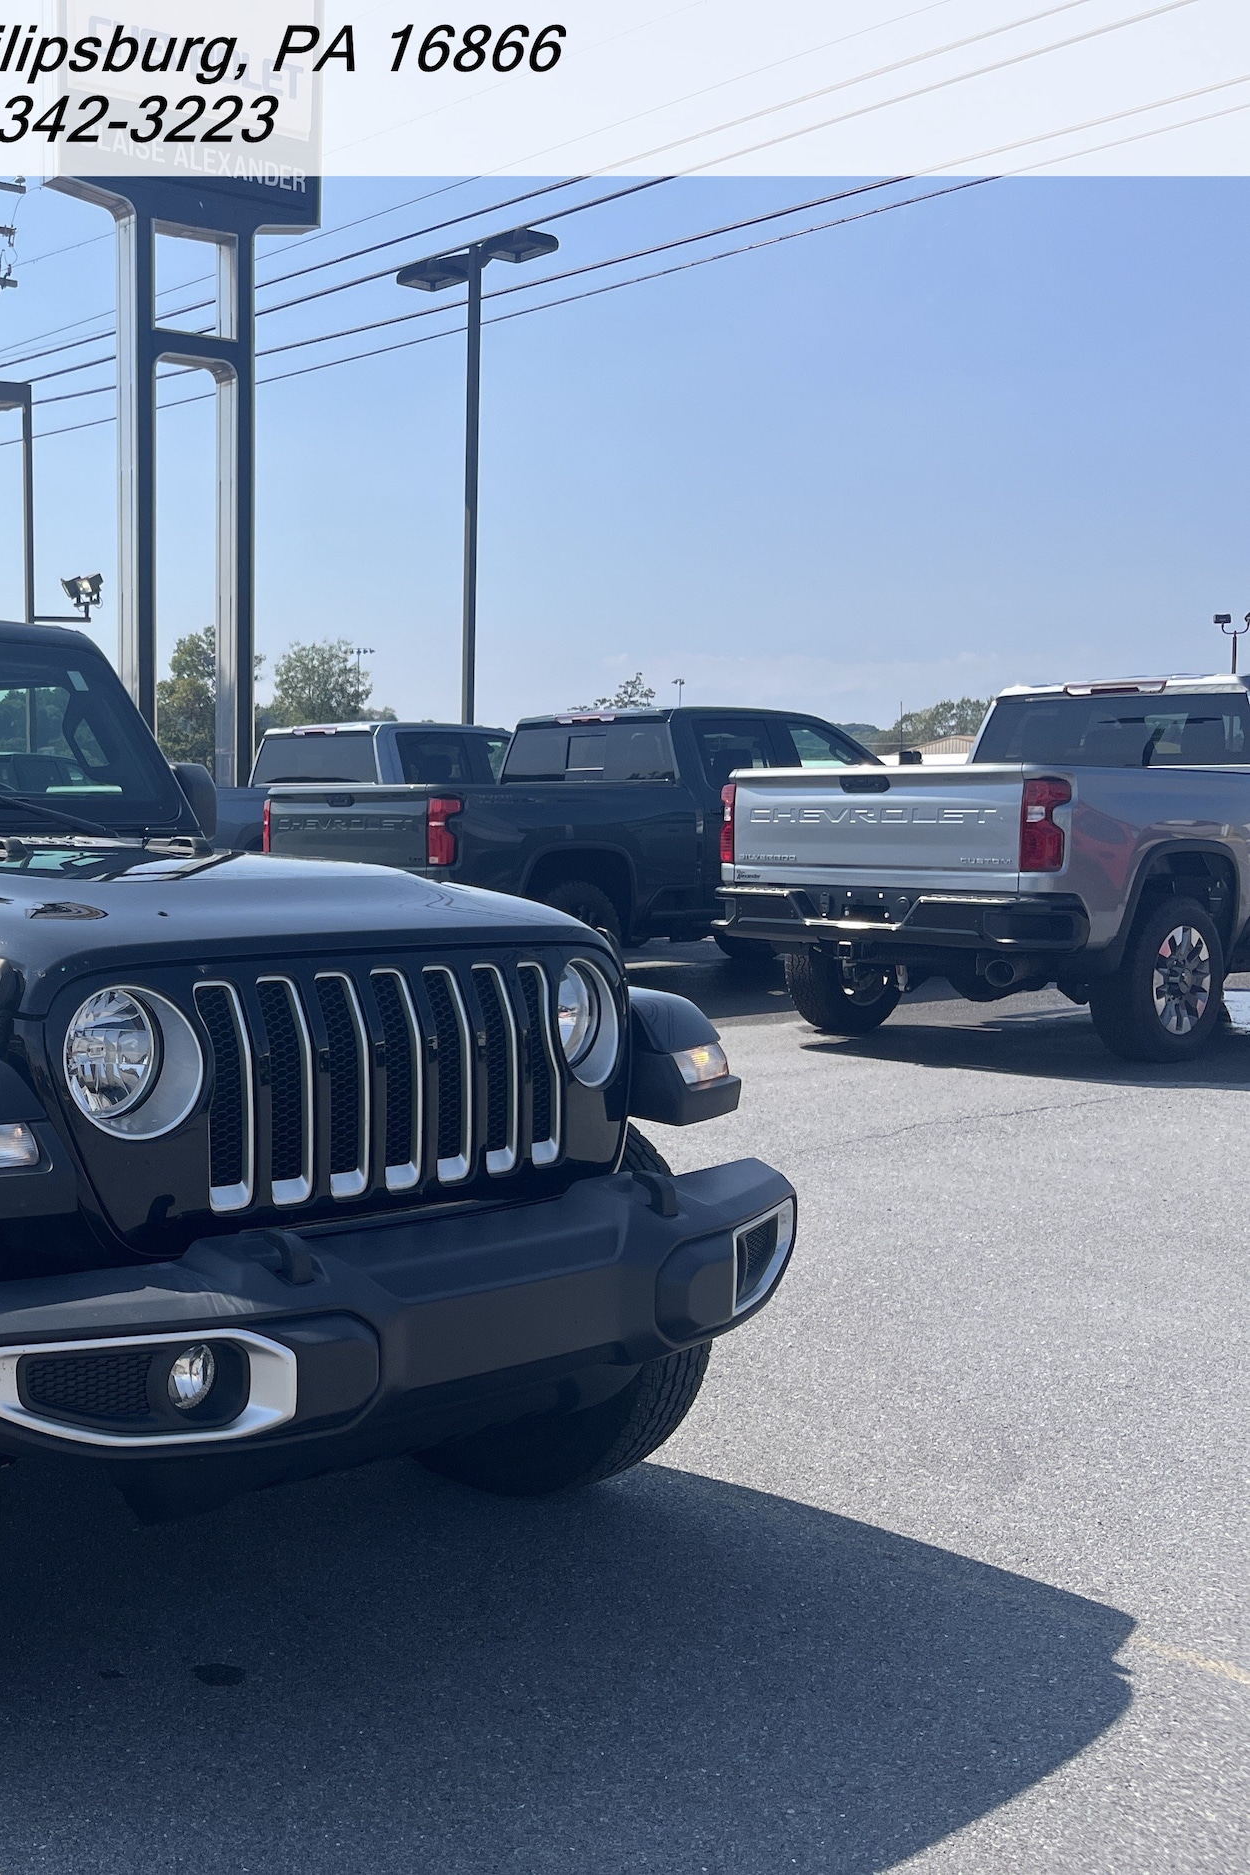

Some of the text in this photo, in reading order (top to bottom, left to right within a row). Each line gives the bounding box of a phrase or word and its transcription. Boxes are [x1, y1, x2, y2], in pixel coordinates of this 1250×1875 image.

[173, 142, 306, 194] ALEXANDER
[750, 808, 997, 824] CHEVROLET
[278, 819, 413, 831] CHEVROLET
[960, 857, 1012, 865] CUSTOM
